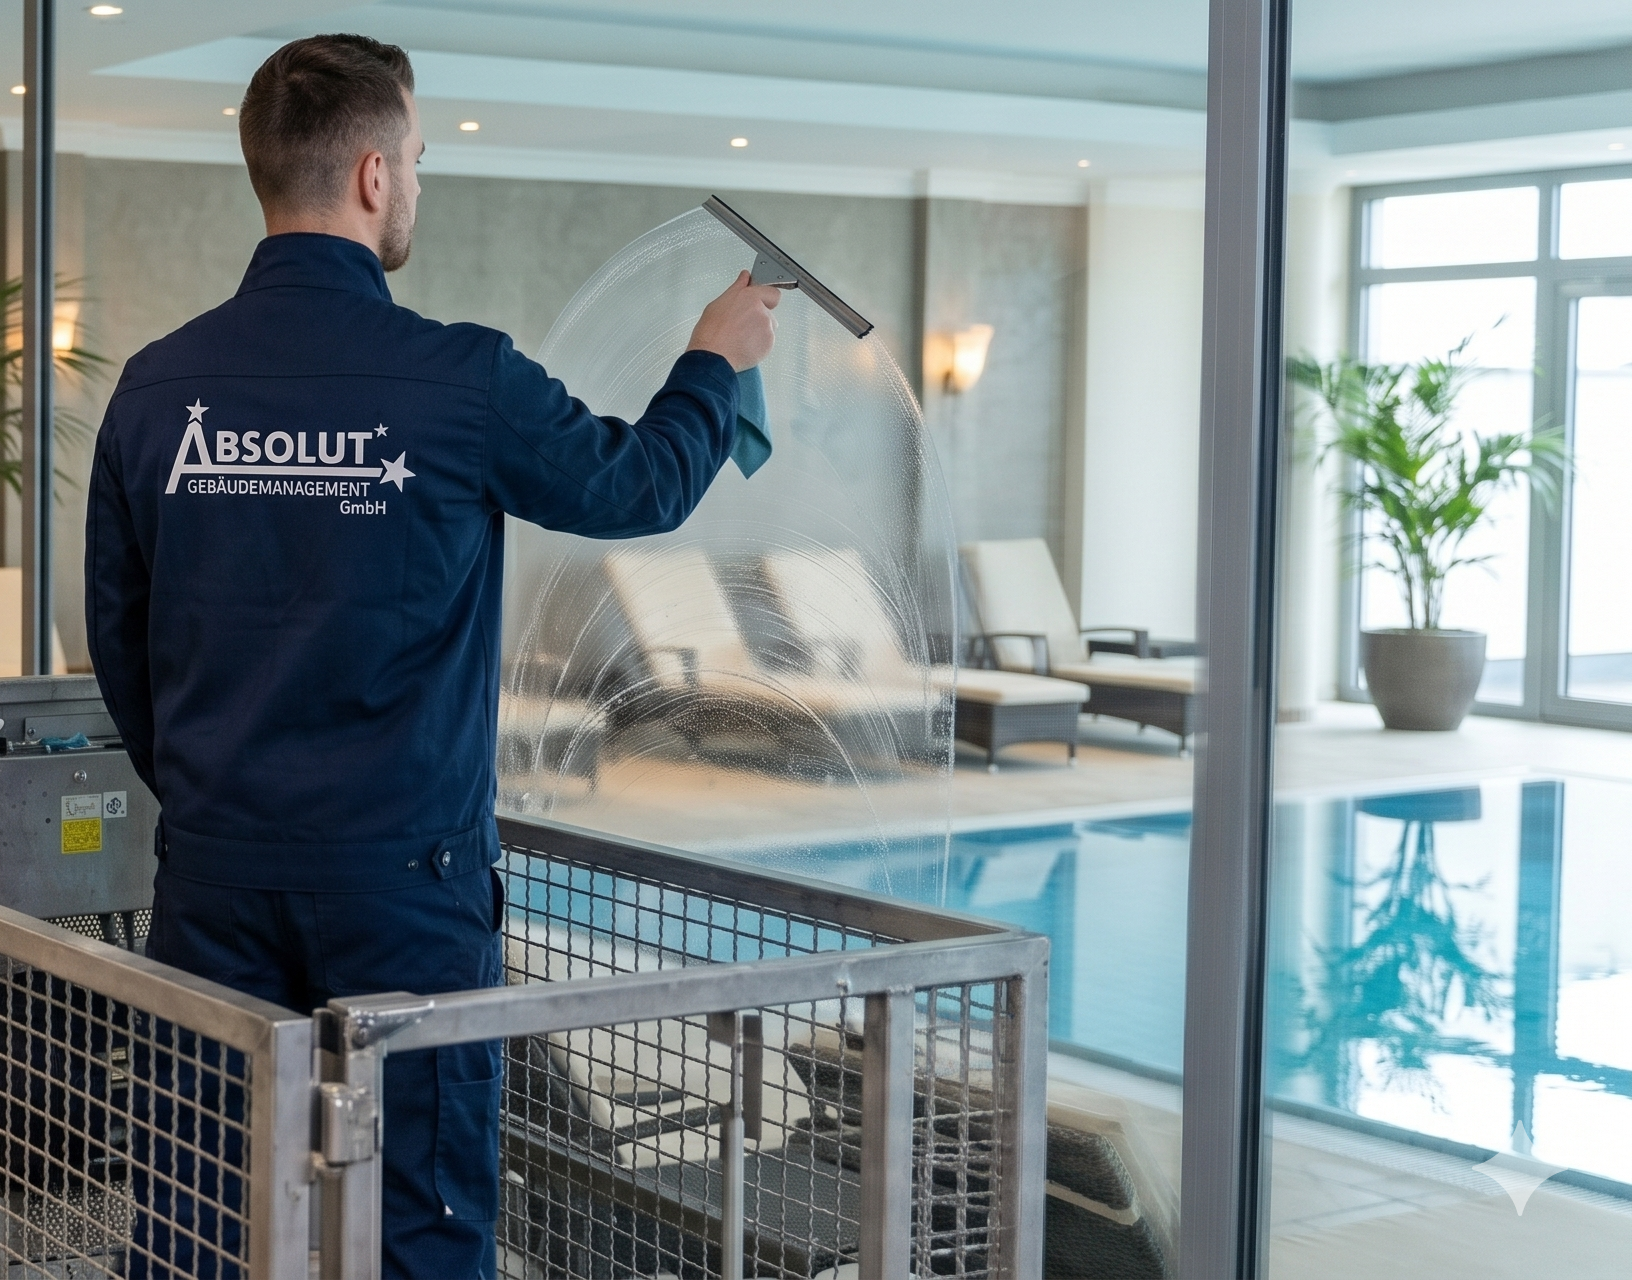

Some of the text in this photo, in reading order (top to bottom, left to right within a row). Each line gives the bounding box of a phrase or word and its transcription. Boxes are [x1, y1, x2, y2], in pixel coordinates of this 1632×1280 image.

[165, 420, 373, 494] ABSOLUT
[187, 476, 371, 497] GEBÄUDEMANAGEMENT
[339, 500, 387, 515] GmbH
